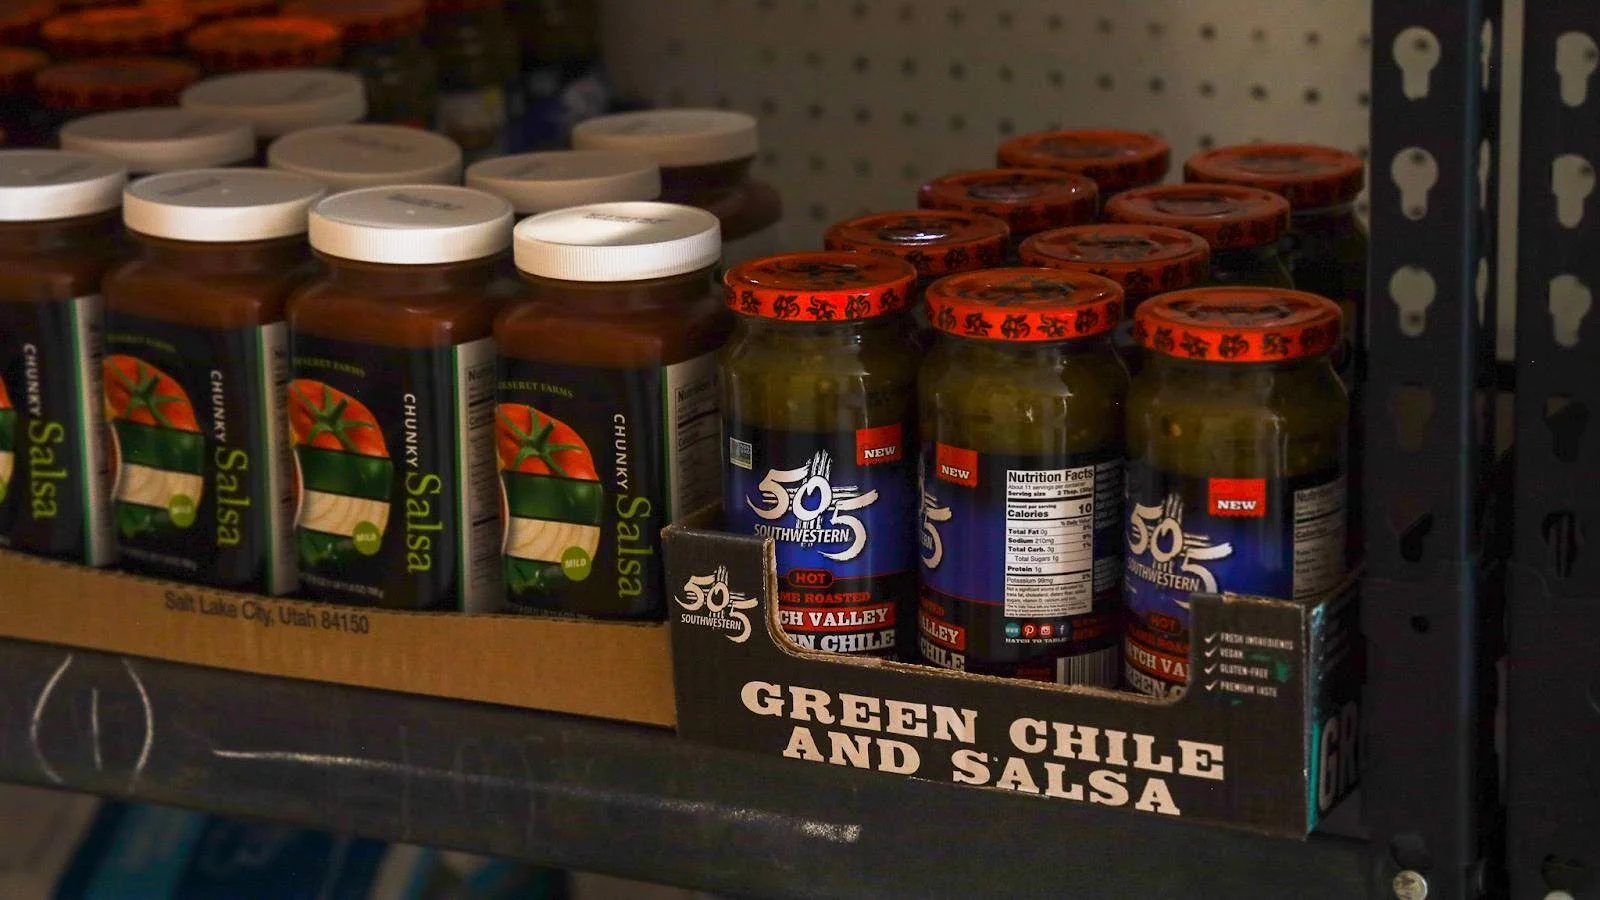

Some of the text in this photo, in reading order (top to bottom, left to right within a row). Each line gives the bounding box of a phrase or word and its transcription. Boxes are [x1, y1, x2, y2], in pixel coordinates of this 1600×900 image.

[23, 342, 44, 416] CHUNKY
[210, 369, 226, 443] CHUNKY
[403, 393, 419, 467] CHUNKY
[613, 413, 630, 490] CHUNKY
[864, 446, 896, 459] NEW
[28, 420, 68, 520] Salsa
[941, 464, 970, 480] NEW
[1008, 468, 1094, 483] Nutrition Facts
[213, 446, 253, 546] Salsa
[1216, 500, 1257, 510] NEW
[405, 472, 444, 573] Salsa
[746, 462, 879, 562] 505
[1008, 503, 1092, 518] Calories 10
[754, 523, 850, 543] SOUTHWESTERN
[615, 494, 656, 599] Salsa
[1030, 555, 1050, 563] Sugars
[1052, 555, 1059, 563] 1g
[565, 558, 586, 569] MILD
[1128, 558, 1200, 592] SOUTHWESTERN
[795, 573, 826, 584] HOT
[674, 573, 759, 643] 505
[805, 591, 872, 603] ROASTED
[165, 590, 369, 634] Salt Lake City, Utah 84150
[681, 613, 742, 630] SOUTHWESTERN
[779, 608, 889, 627] CH VALLEY
[820, 628, 896, 653] CHILE
[1220, 633, 1243, 643] FRESH
[920, 637, 965, 671] CHILE
[1220, 648, 1244, 659] VEGAN
[1220, 681, 1277, 698] PREMIUM TASTE
[740, 680, 1225, 781] GREEN CHILE
[782, 727, 1181, 816] AND SALSA
